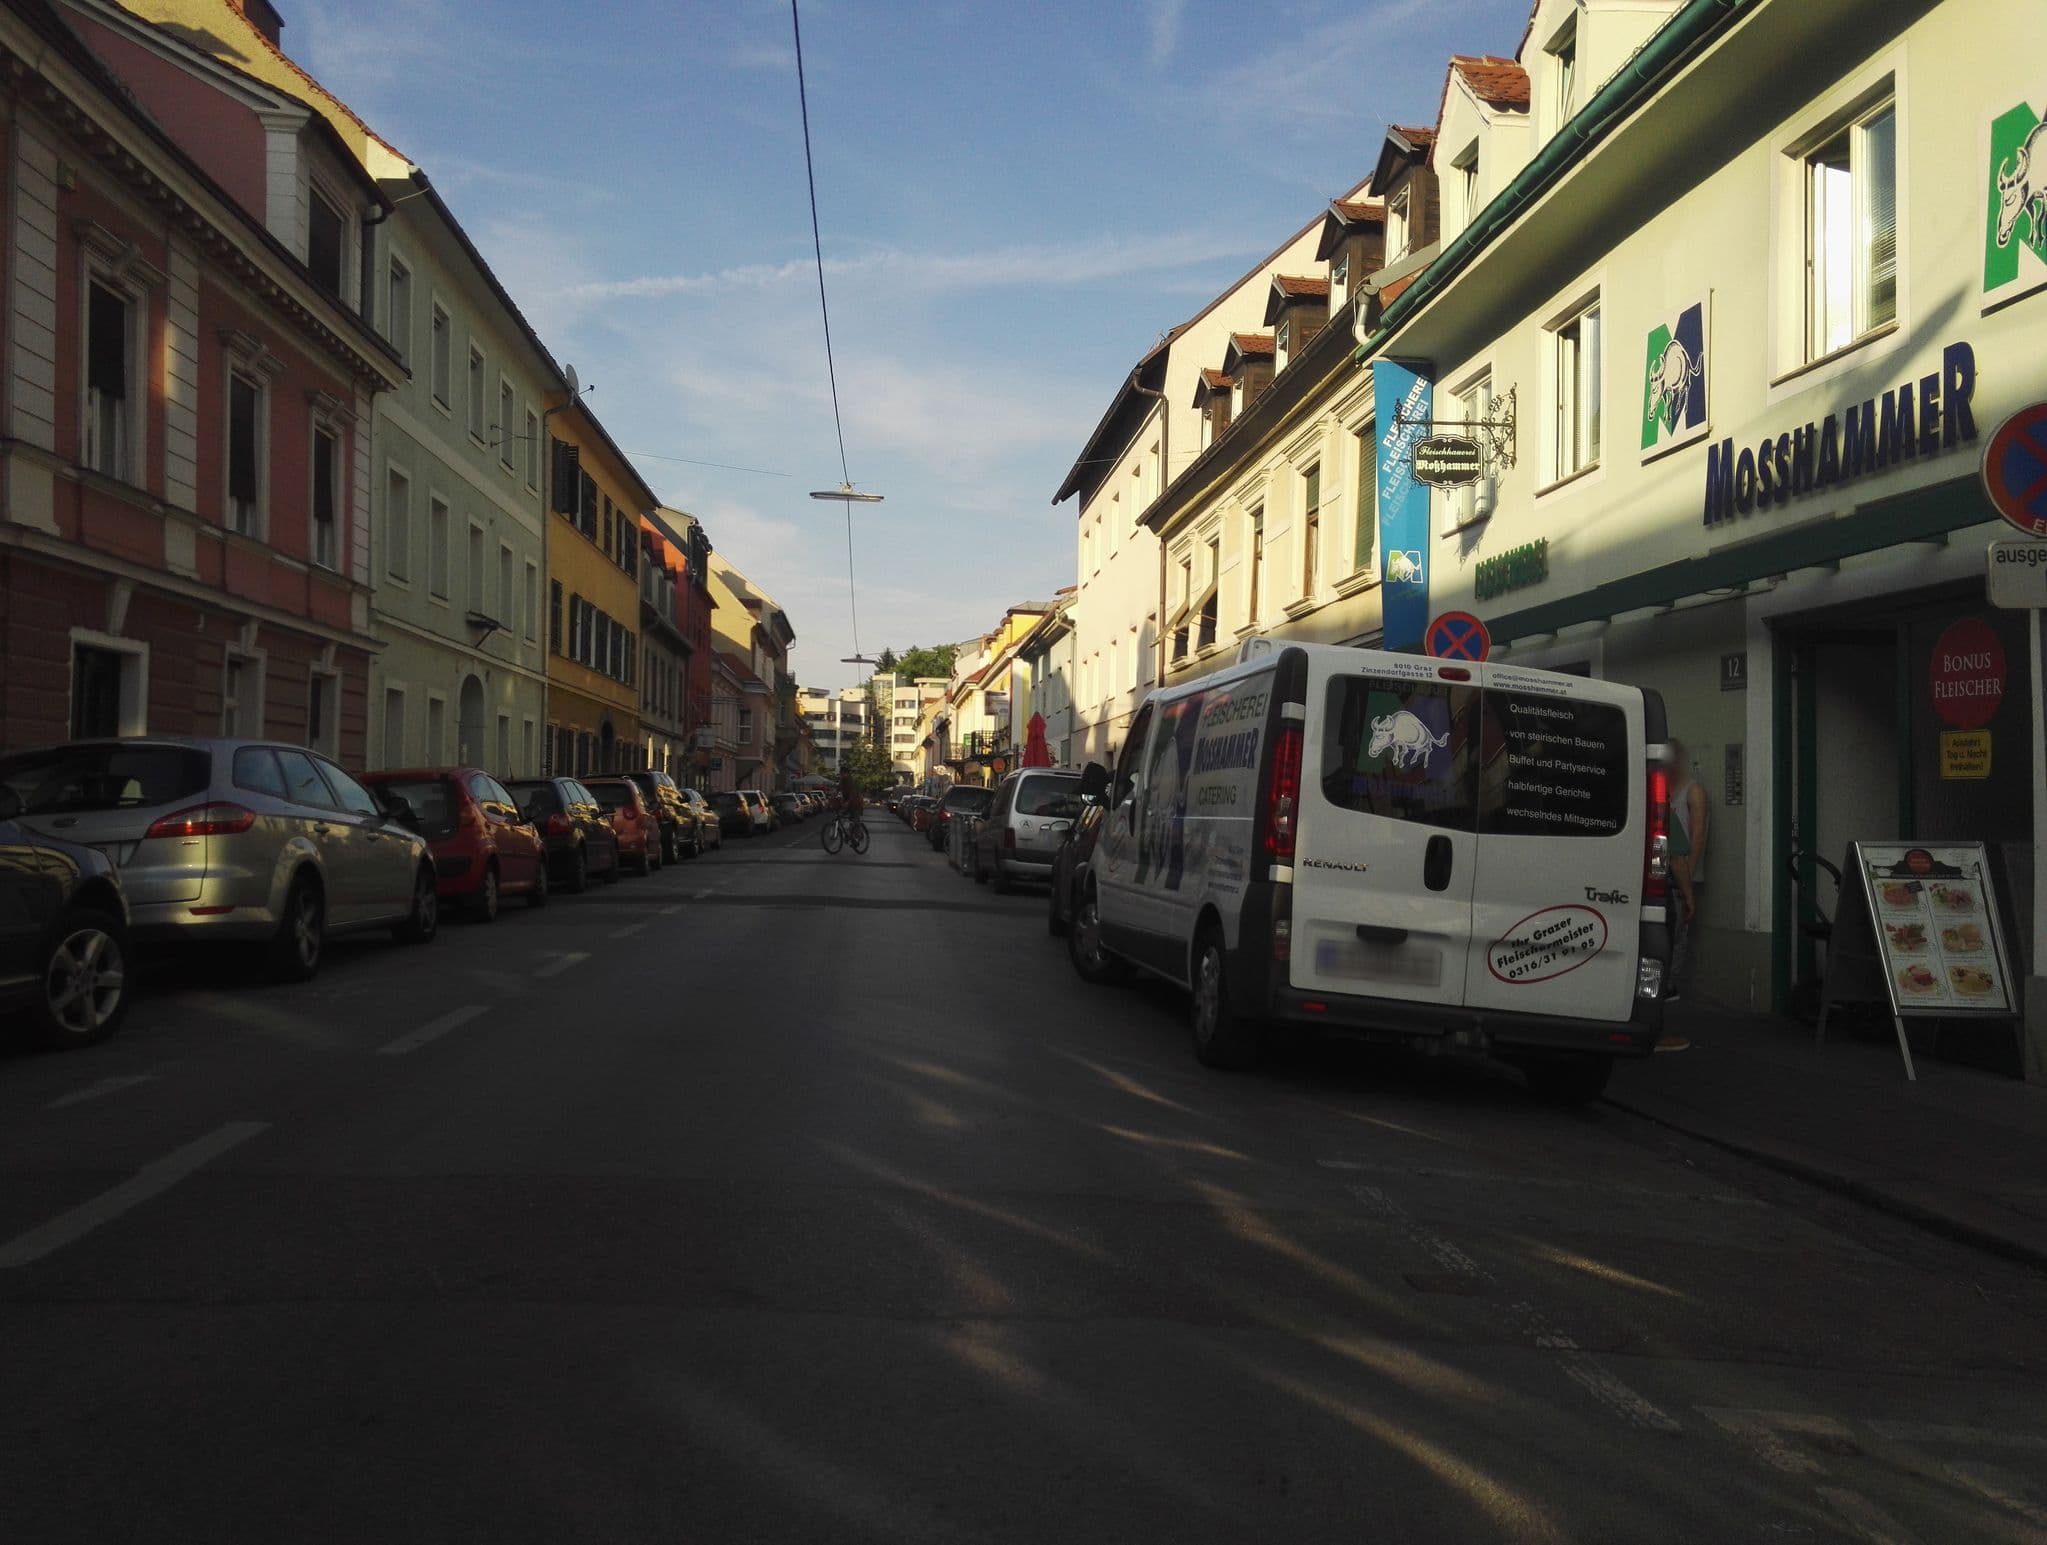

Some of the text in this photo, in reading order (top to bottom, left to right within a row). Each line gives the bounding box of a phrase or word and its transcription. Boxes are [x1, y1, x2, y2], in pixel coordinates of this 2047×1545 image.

[1382, 374, 1428, 448] FLECHEREI
[1703, 341, 1979, 526] MOSSHAMMER
[1418, 445, 1476, 456] Fleischhauerei
[1361, 667, 1424, 678] Zinzendorfgasse
[1728, 657, 1740, 678] 12
[1943, 652, 1992, 673] BONUS
[1492, 672, 1574, 688] office@mosshammer.at
[1493, 682, 1567, 695] www.mosshammer.at
[1935, 678, 2002, 699] FLEISCHER
[1509, 703, 1574, 720] Qualitätsfleisch
[1197, 727, 1259, 773] MOSSHAMMER
[1509, 730, 1605, 750] von steirischen Bauern
[1508, 754, 1606, 776] Buffet und Partyservice
[1199, 785, 1237, 806] CATERING
[1508, 780, 1591, 799] halbfertige Gerichte
[1507, 807, 1617, 829] wechselndes Mittagsmenü
[1303, 858, 1369, 872] RENAULT
[1585, 887, 1630, 904] Trafic
[1533, 917, 1572, 941] Grazer
[1497, 922, 1595, 968] Fleischermeister
[1509, 952, 1557, 979] 0316/31
